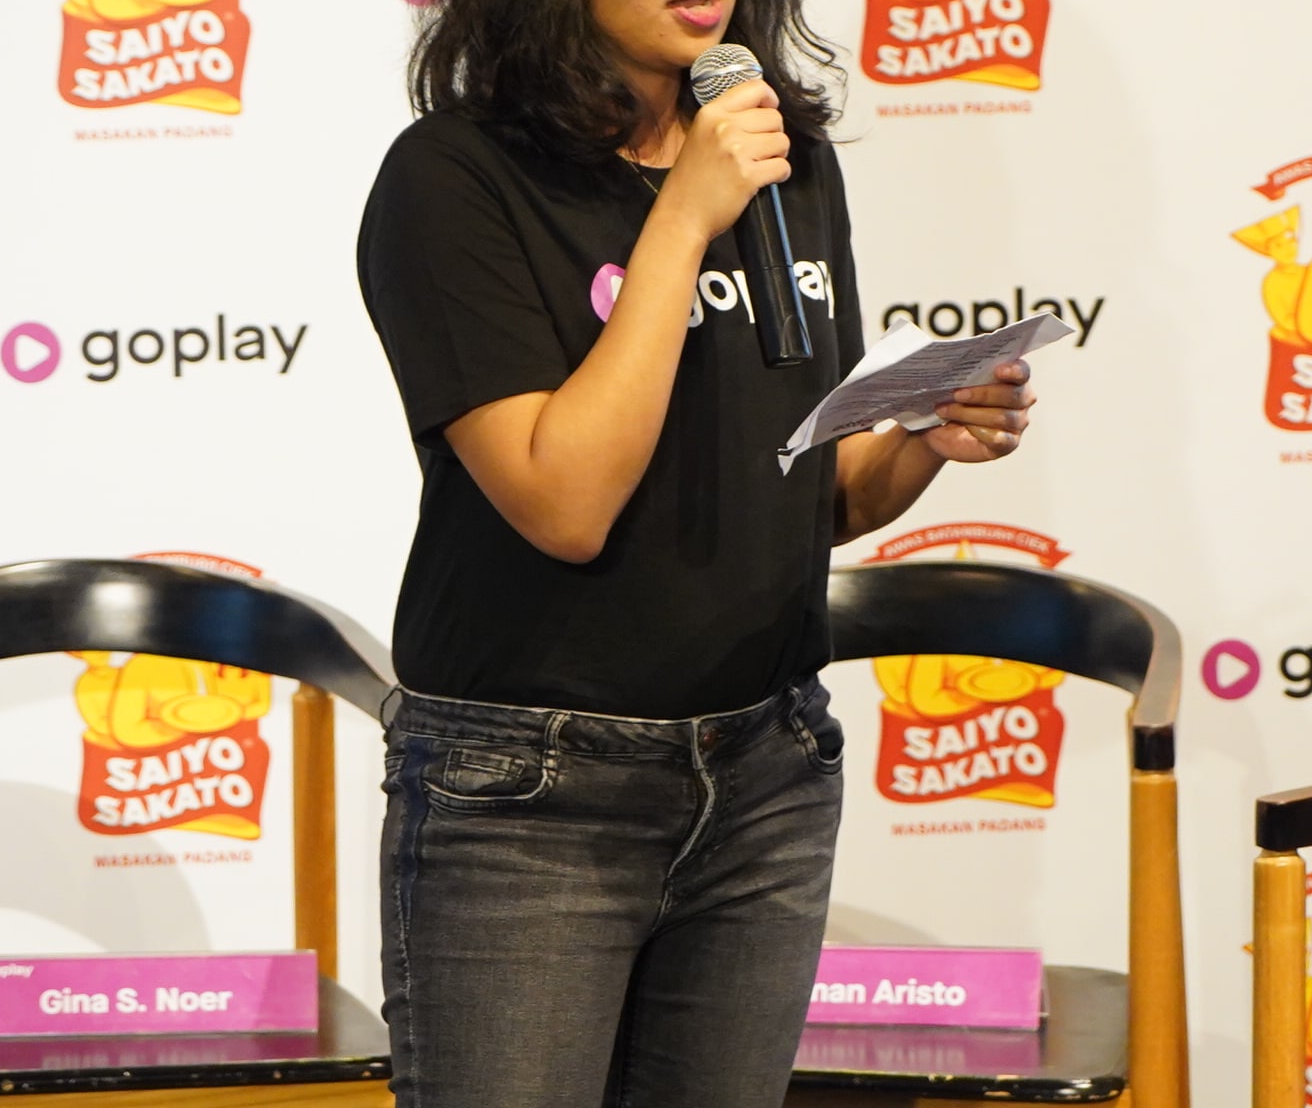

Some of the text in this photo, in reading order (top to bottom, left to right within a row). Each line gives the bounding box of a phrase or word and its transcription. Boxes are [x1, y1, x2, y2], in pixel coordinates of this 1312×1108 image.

[86, 9, 224, 65] SAIYO
[876, 23, 1033, 77] SAKATO
[74, 47, 233, 100] SAKATO
[877, 100, 1032, 117] MASAKAN PADANG
[81, 314, 308, 383] goplay
[902, 705, 1039, 760] SAIYO
[104, 736, 244, 792] SAIYO
[889, 742, 1048, 796] SAKATO
[91, 773, 254, 827] SAKATO
[891, 818, 1046, 836] MASAKAN PADANG
[39, 987, 233, 1014] Gina S. Noer
[872, 978, 967, 1006] Aristo
